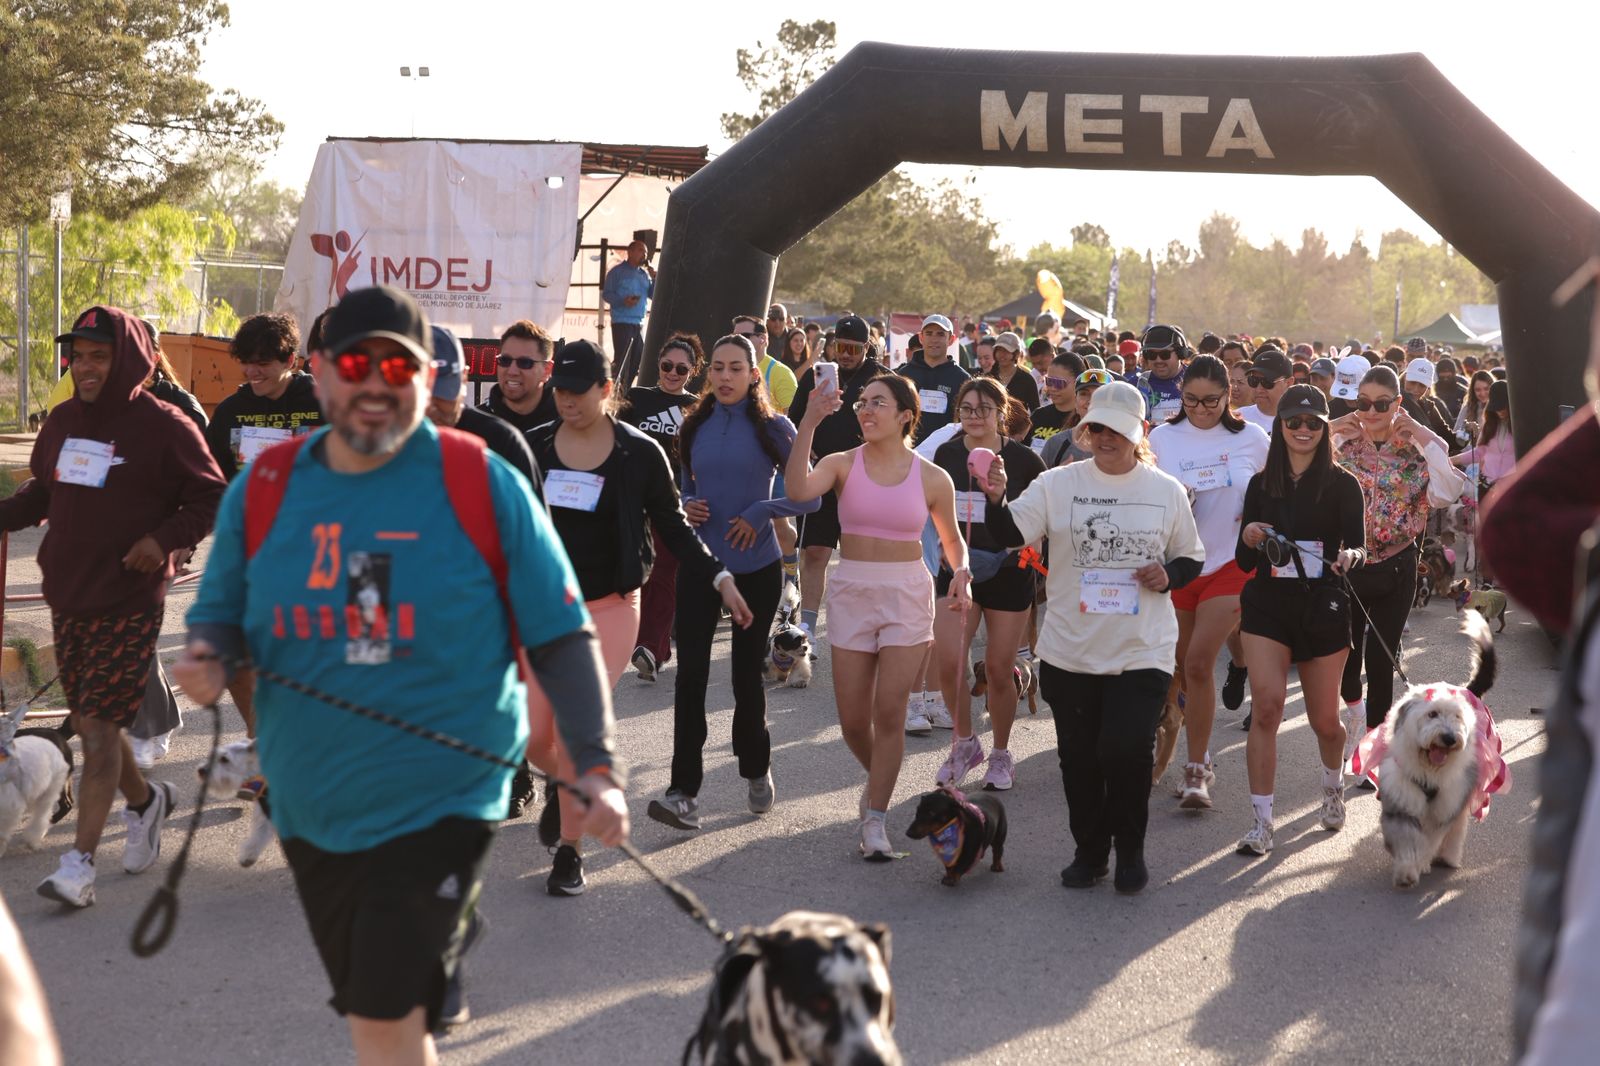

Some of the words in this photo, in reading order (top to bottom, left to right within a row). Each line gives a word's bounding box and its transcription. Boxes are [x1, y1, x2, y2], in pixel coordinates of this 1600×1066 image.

[980, 89, 1276, 159] META
[370, 256, 493, 292] IMDEJ
[306, 522, 343, 590] 23
[1101, 588, 1119, 598] 037
